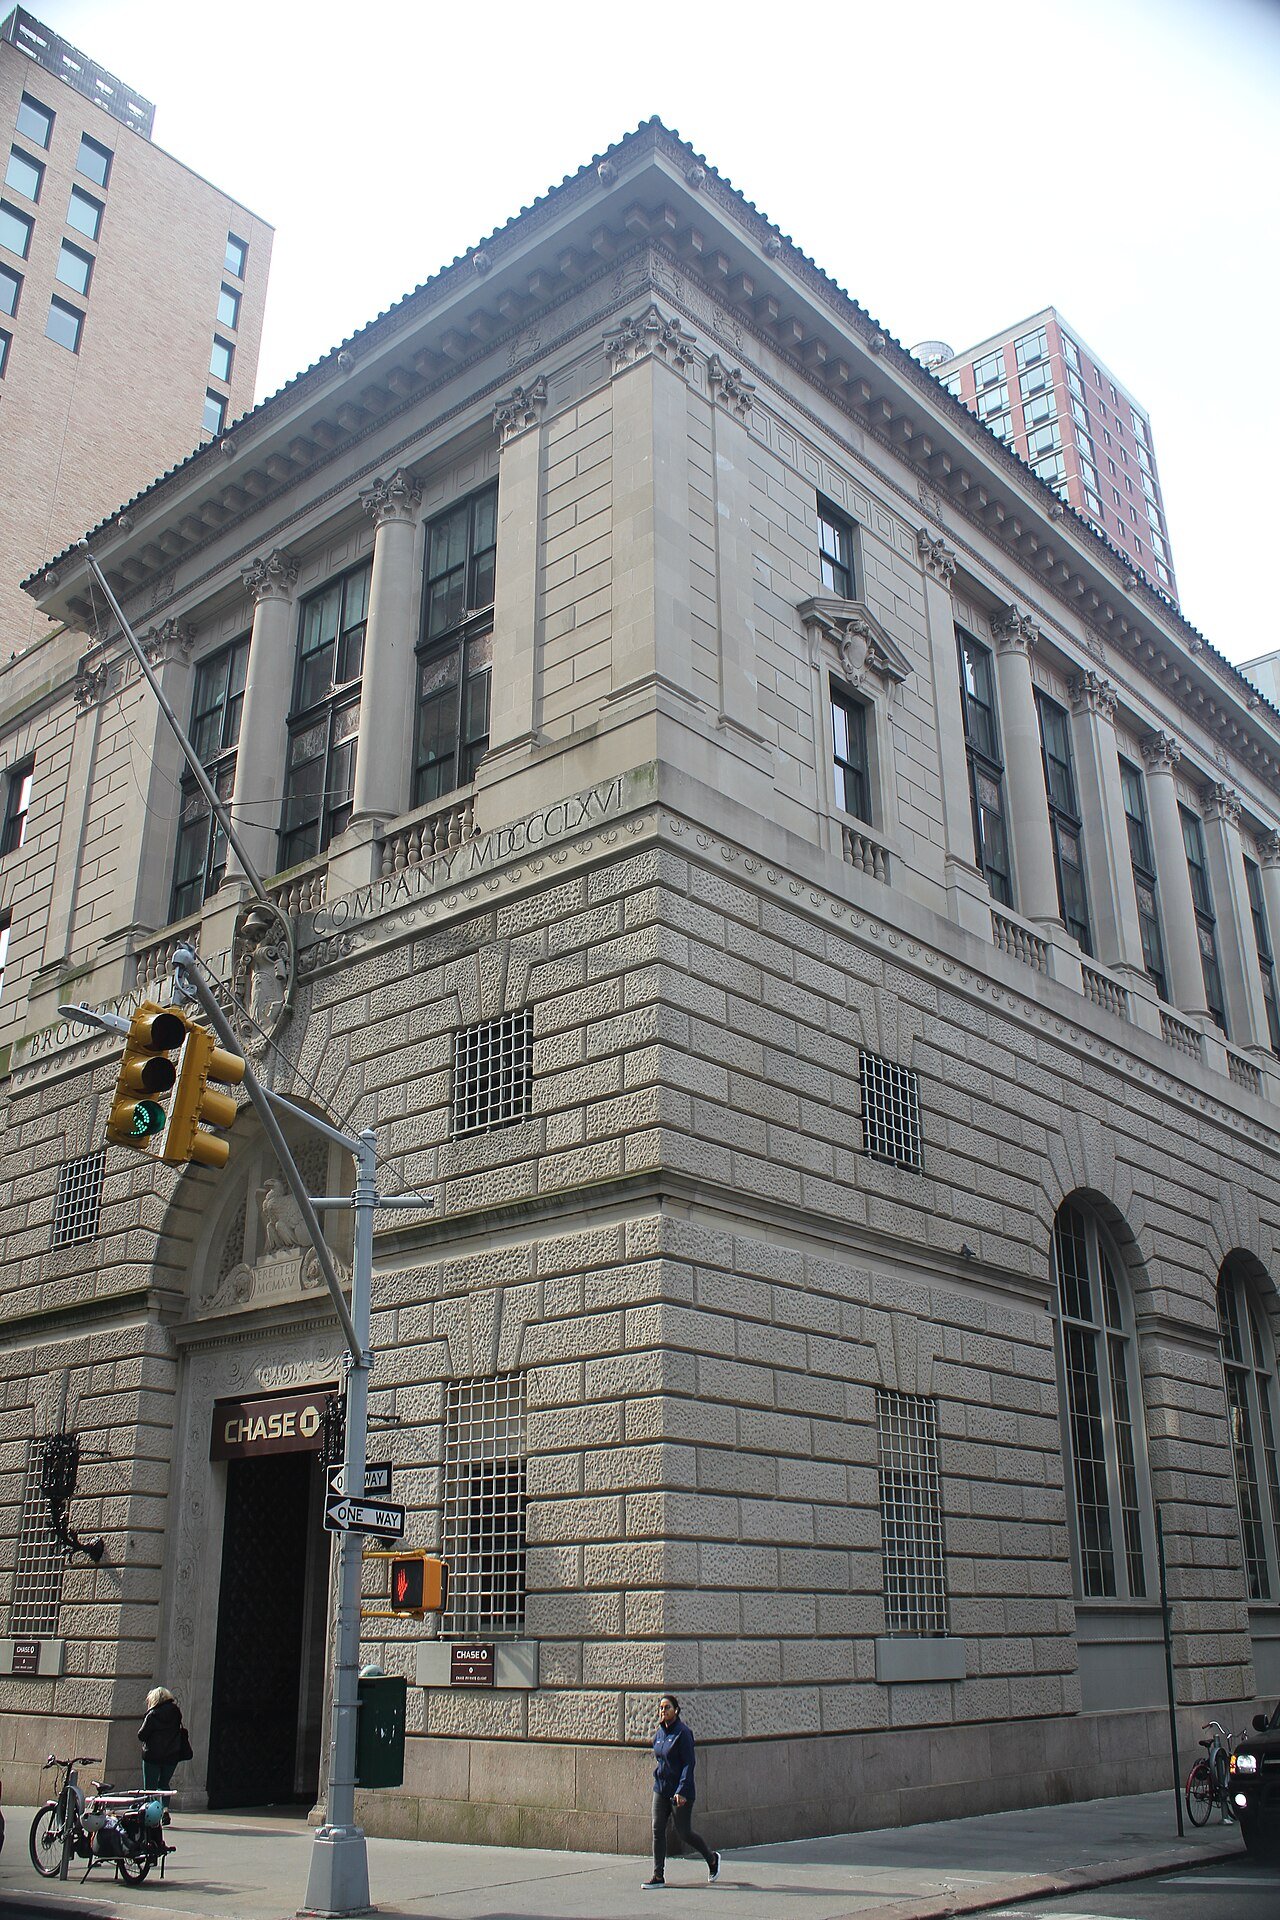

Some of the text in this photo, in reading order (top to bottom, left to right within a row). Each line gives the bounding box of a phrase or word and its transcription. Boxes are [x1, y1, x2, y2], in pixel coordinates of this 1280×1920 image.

[154, 949, 231, 1003] TST
[312, 848, 460, 934] COMPANY
[468, 777, 623, 871] MDCCCLXVI
[257, 1263, 296, 1281] ERECTED
[256, 1275, 295, 1295] MCMXV
[224, 1411, 297, 1443] CHASE
[338, 1507, 398, 1526] ONE WAY
[456, 1650, 480, 1659] CHASE
